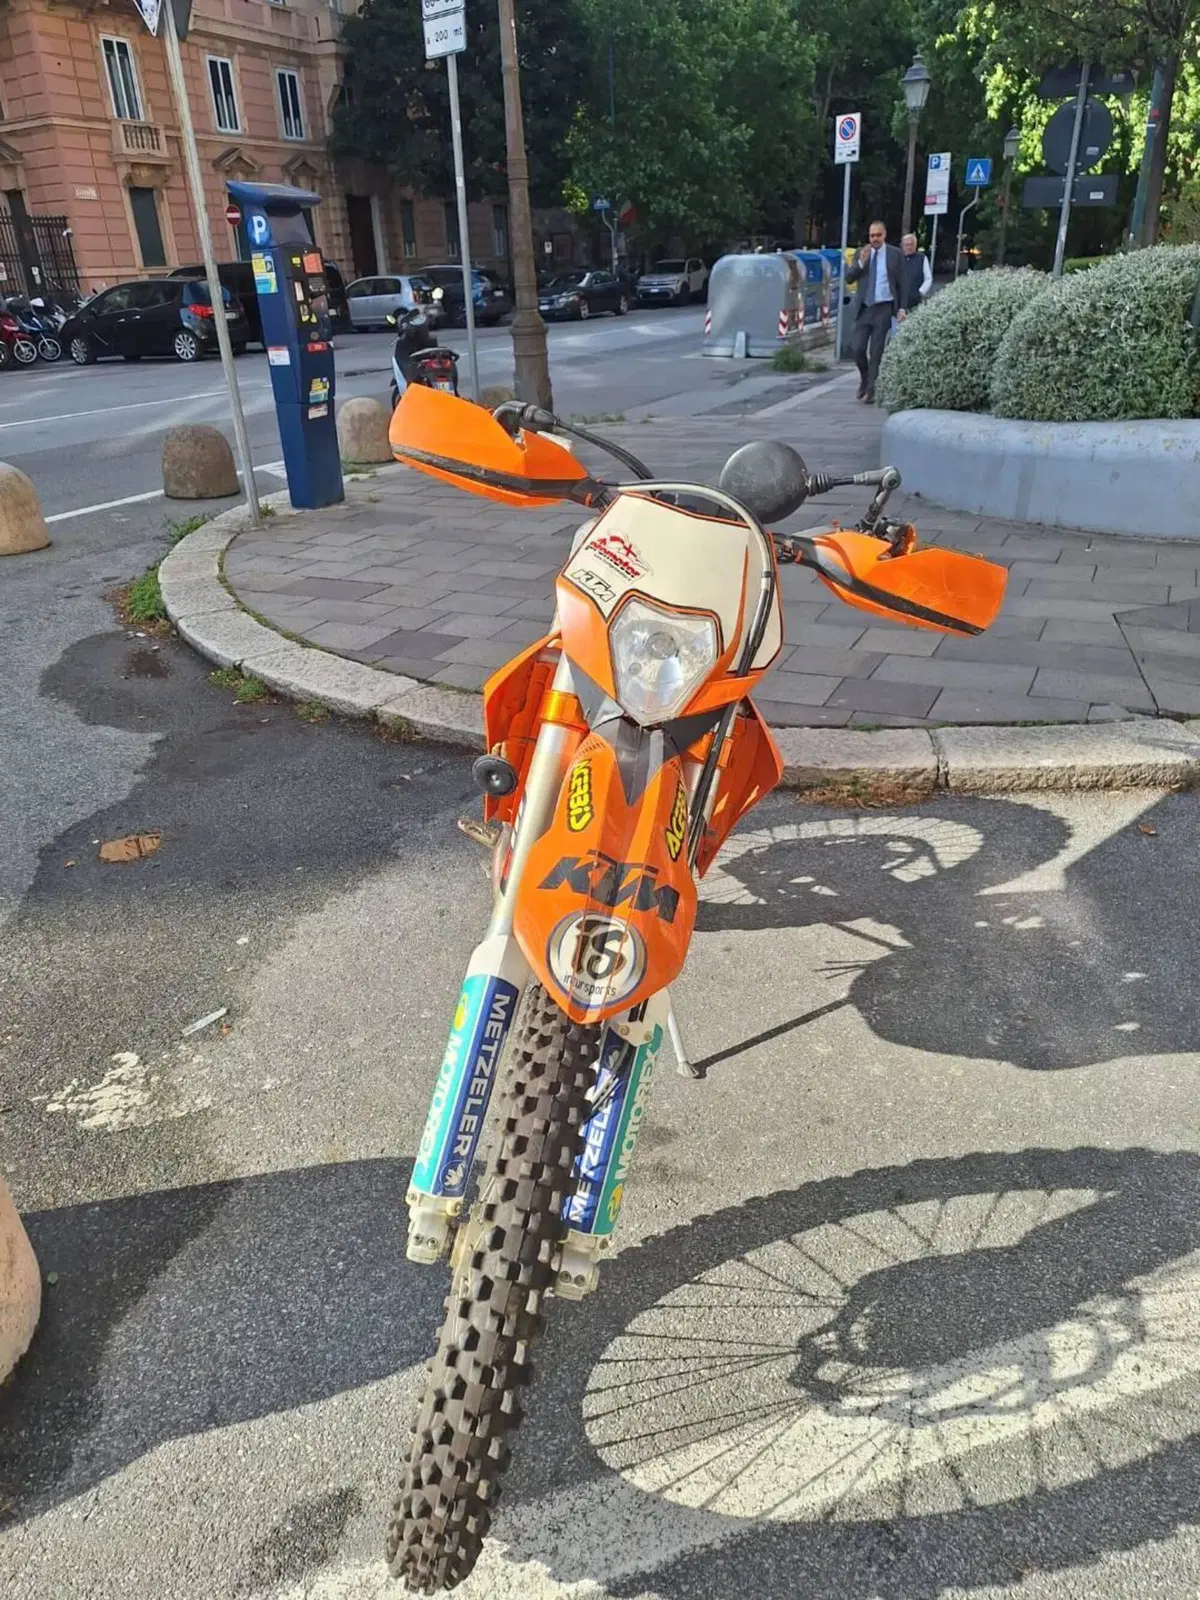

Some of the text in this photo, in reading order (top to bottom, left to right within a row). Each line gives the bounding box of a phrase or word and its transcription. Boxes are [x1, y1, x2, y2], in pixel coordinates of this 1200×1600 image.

[435, 29, 449, 42] 200
[252, 215, 267, 244] P
[570, 569, 617, 603] KTM
[537, 849, 681, 924] KTM
[452, 993, 511, 1157] METZELER
[614, 1047, 658, 1181] MOTOREX
